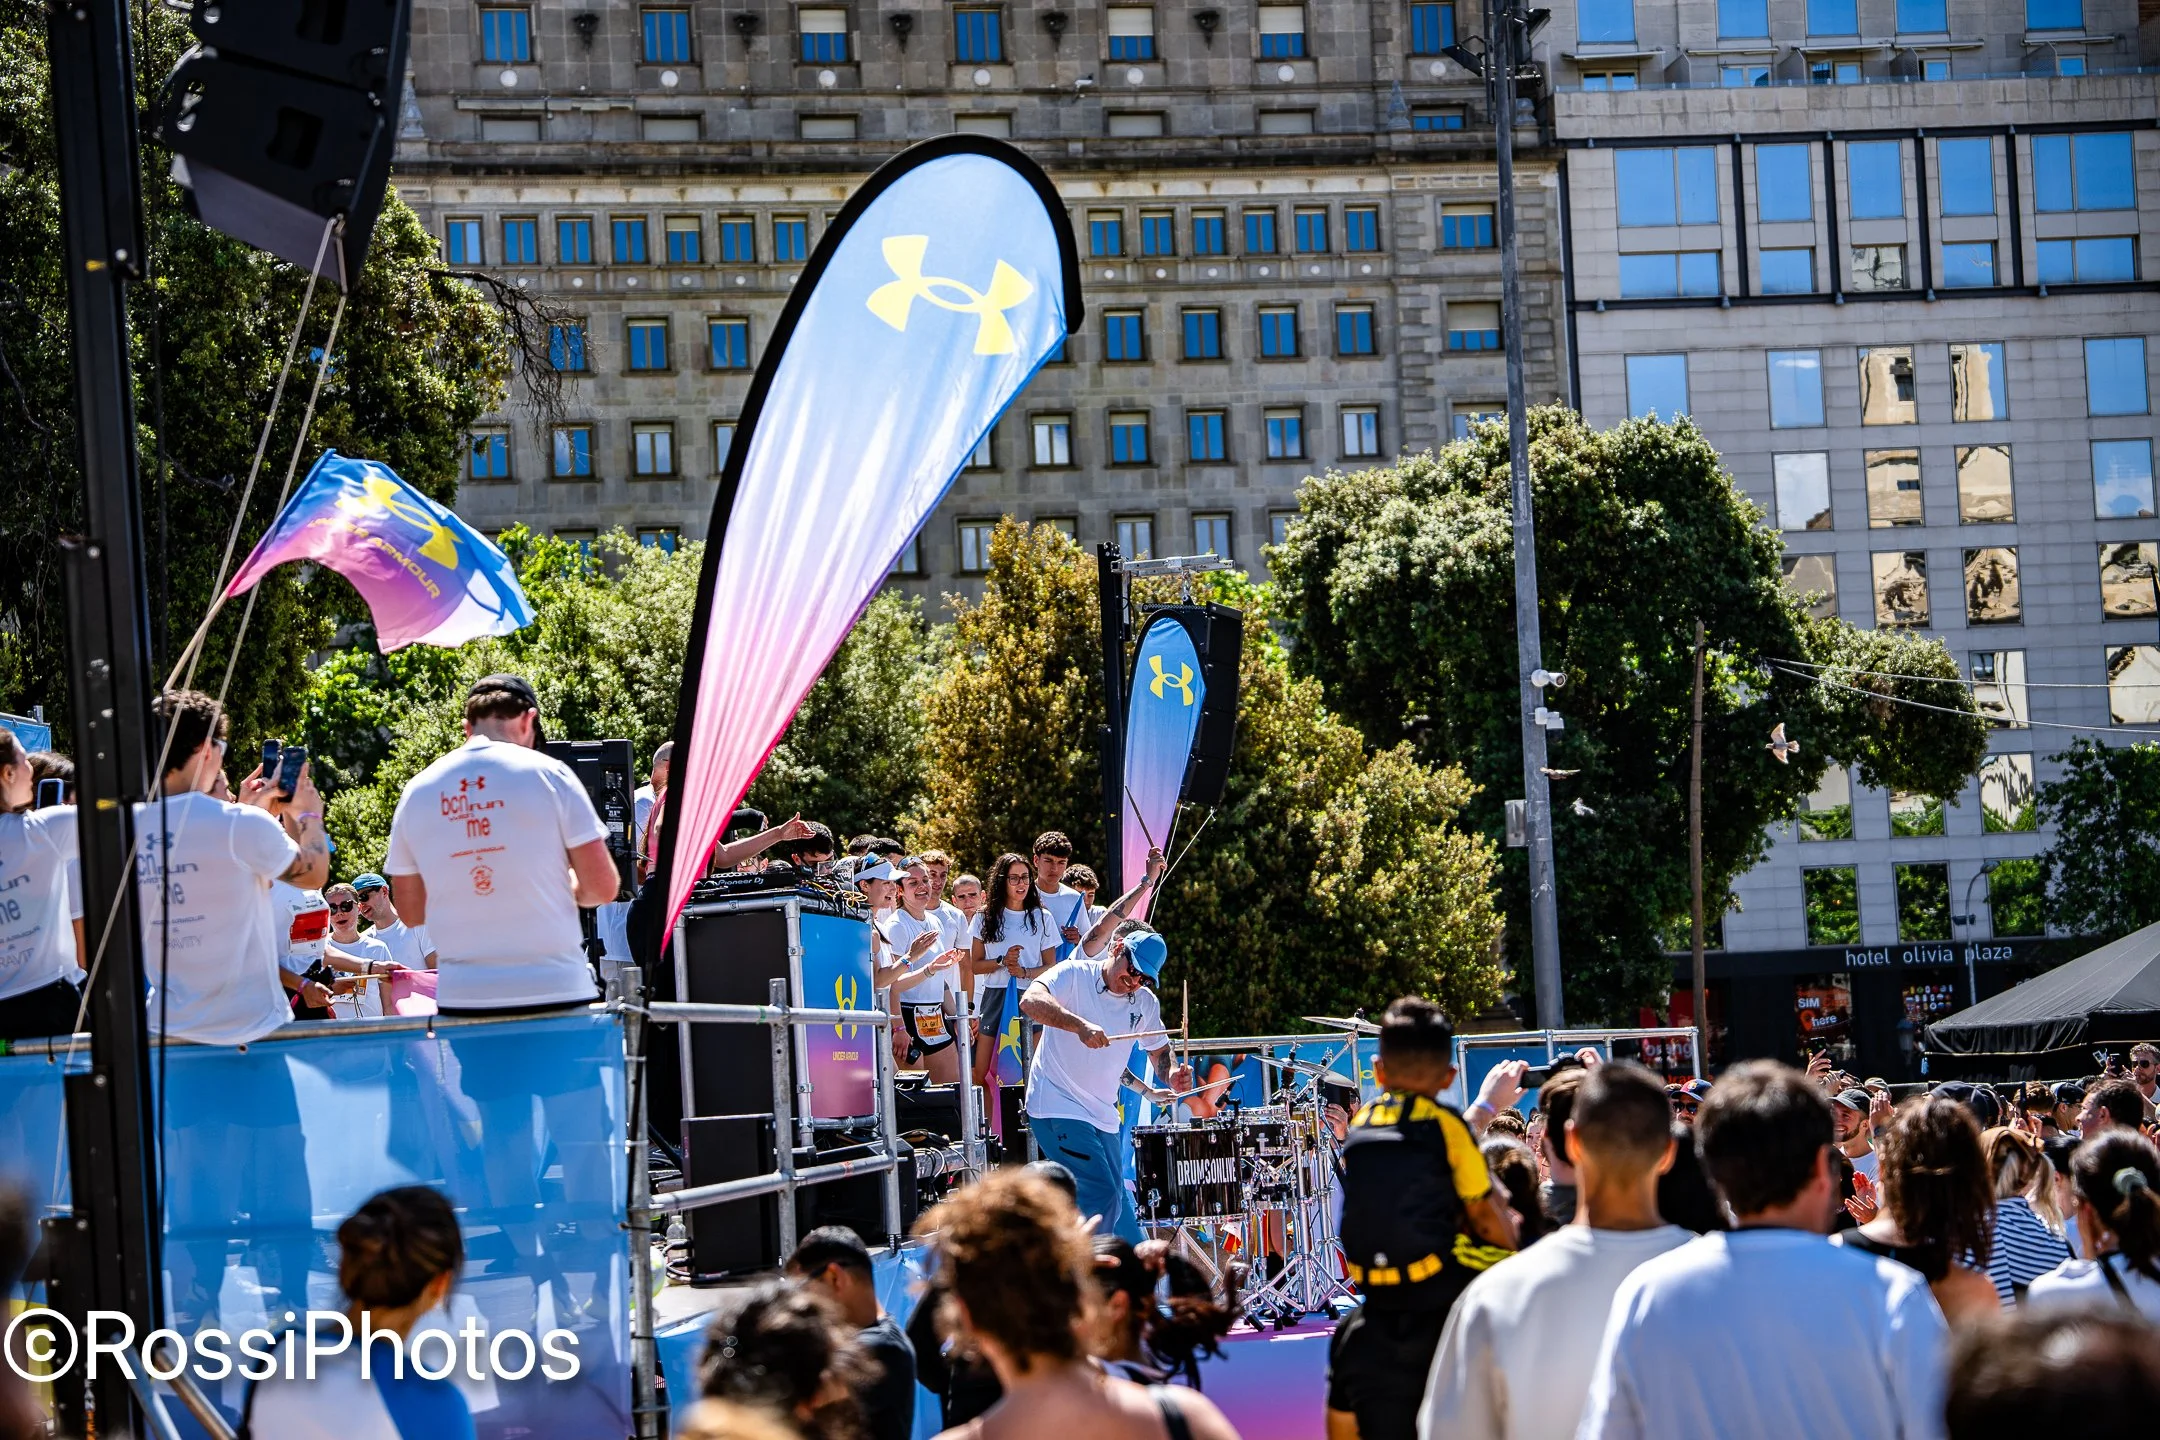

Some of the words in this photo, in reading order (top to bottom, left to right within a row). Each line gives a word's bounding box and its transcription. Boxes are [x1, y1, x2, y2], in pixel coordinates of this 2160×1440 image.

[440, 790, 469, 816] bcn
[466, 817, 491, 838] me
[1845, 947, 1891, 967] hotel
[1903, 945, 1954, 964] olivia
[1964, 943, 2014, 966] plaza
[1797, 997, 1821, 1009] SIM
[1811, 1014, 1838, 1028] here
[1644, 1042, 1694, 1059] orang
[1176, 1157, 1237, 1186] DRUMSONLIVE
